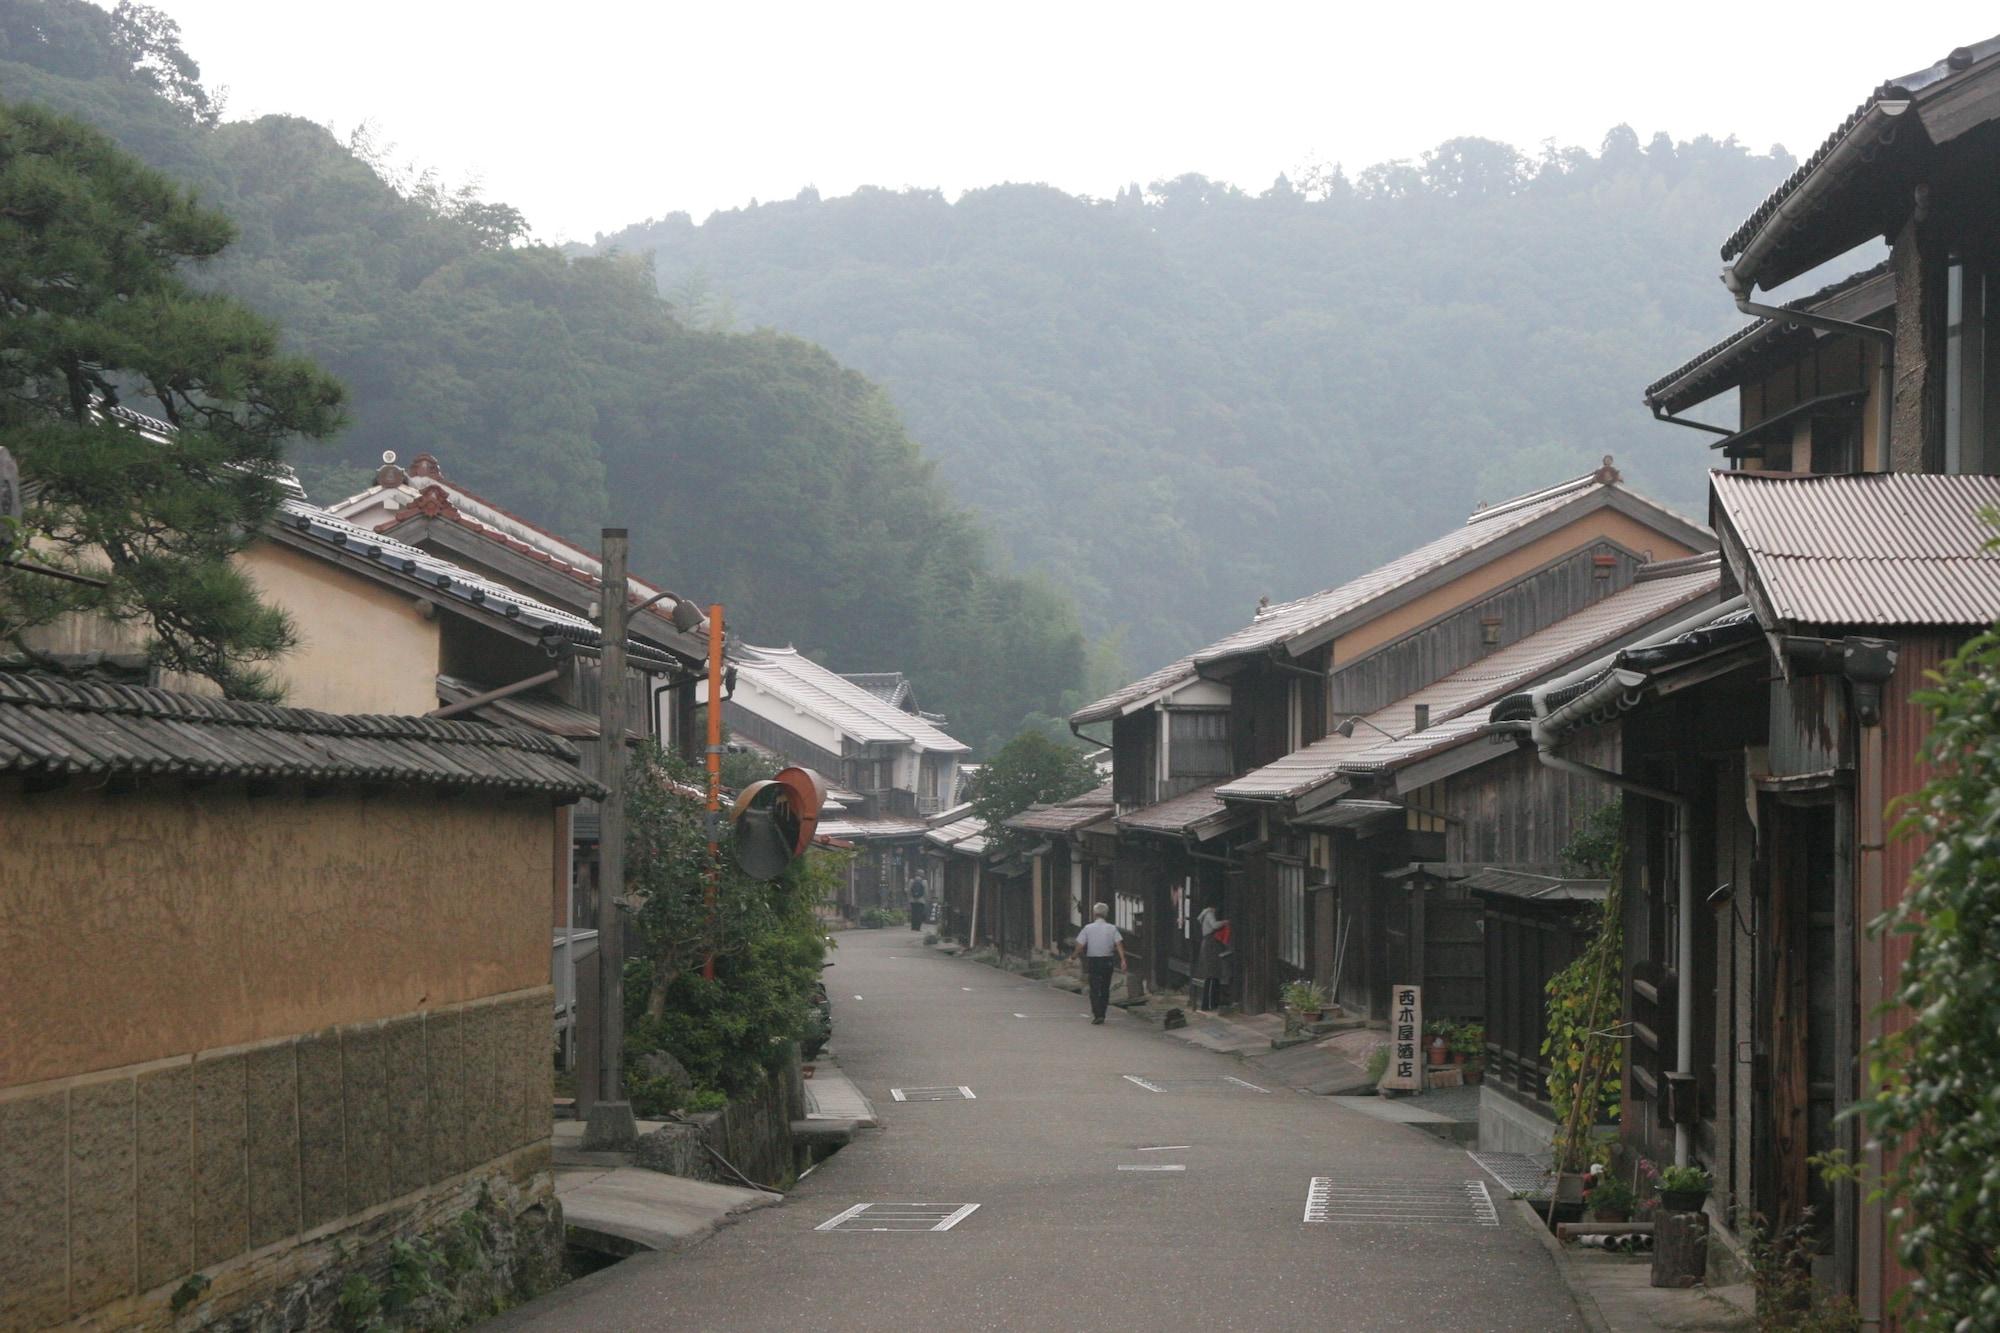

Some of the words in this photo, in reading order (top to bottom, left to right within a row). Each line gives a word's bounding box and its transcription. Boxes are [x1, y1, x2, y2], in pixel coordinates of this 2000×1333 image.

[1397, 989, 1415, 1078] 西木屋酒店
